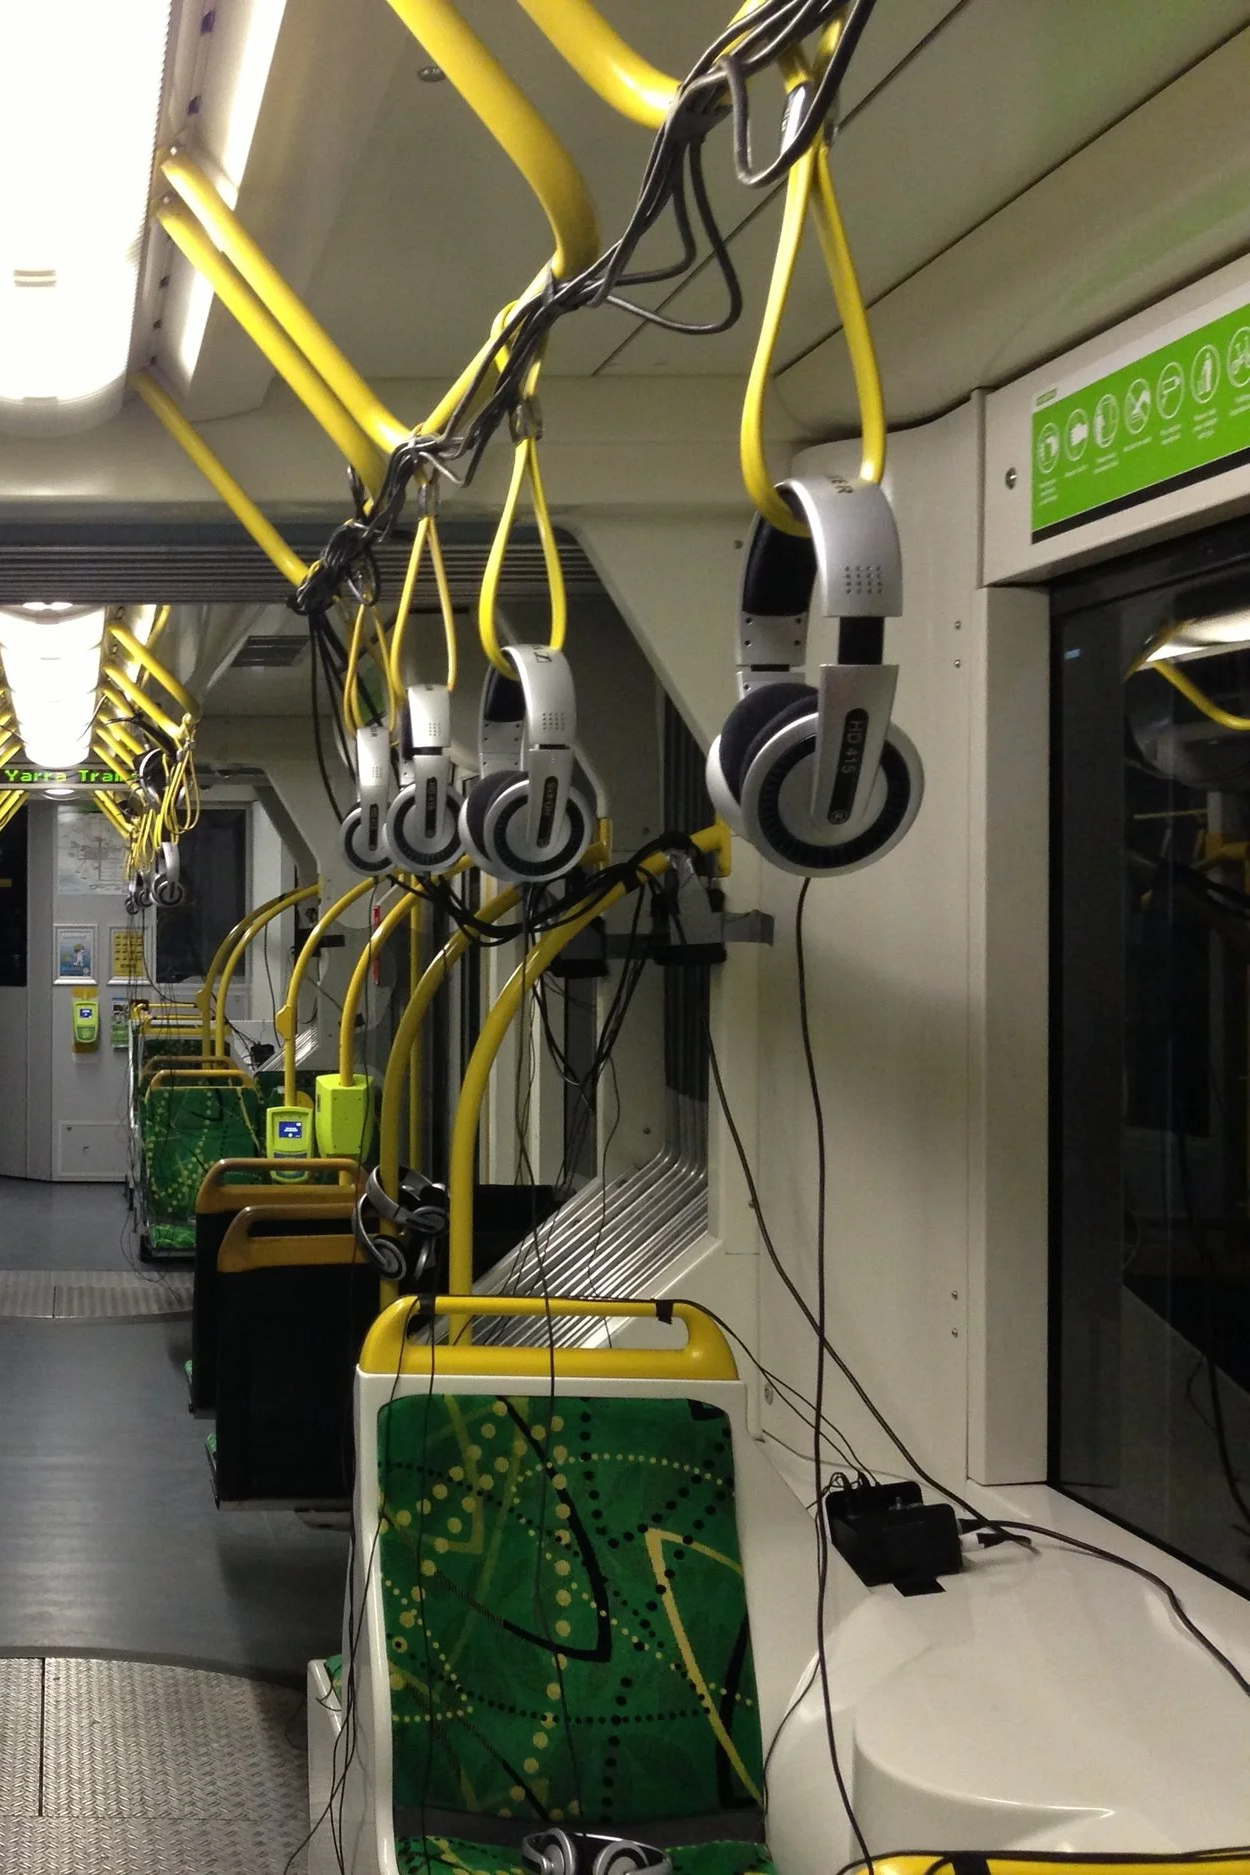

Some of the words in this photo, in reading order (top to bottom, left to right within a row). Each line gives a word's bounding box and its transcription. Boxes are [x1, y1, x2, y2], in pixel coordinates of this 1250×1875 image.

[846, 720, 864, 744] HD
[841, 747, 859, 774] 415
[5, 769, 67, 782] Yarra
